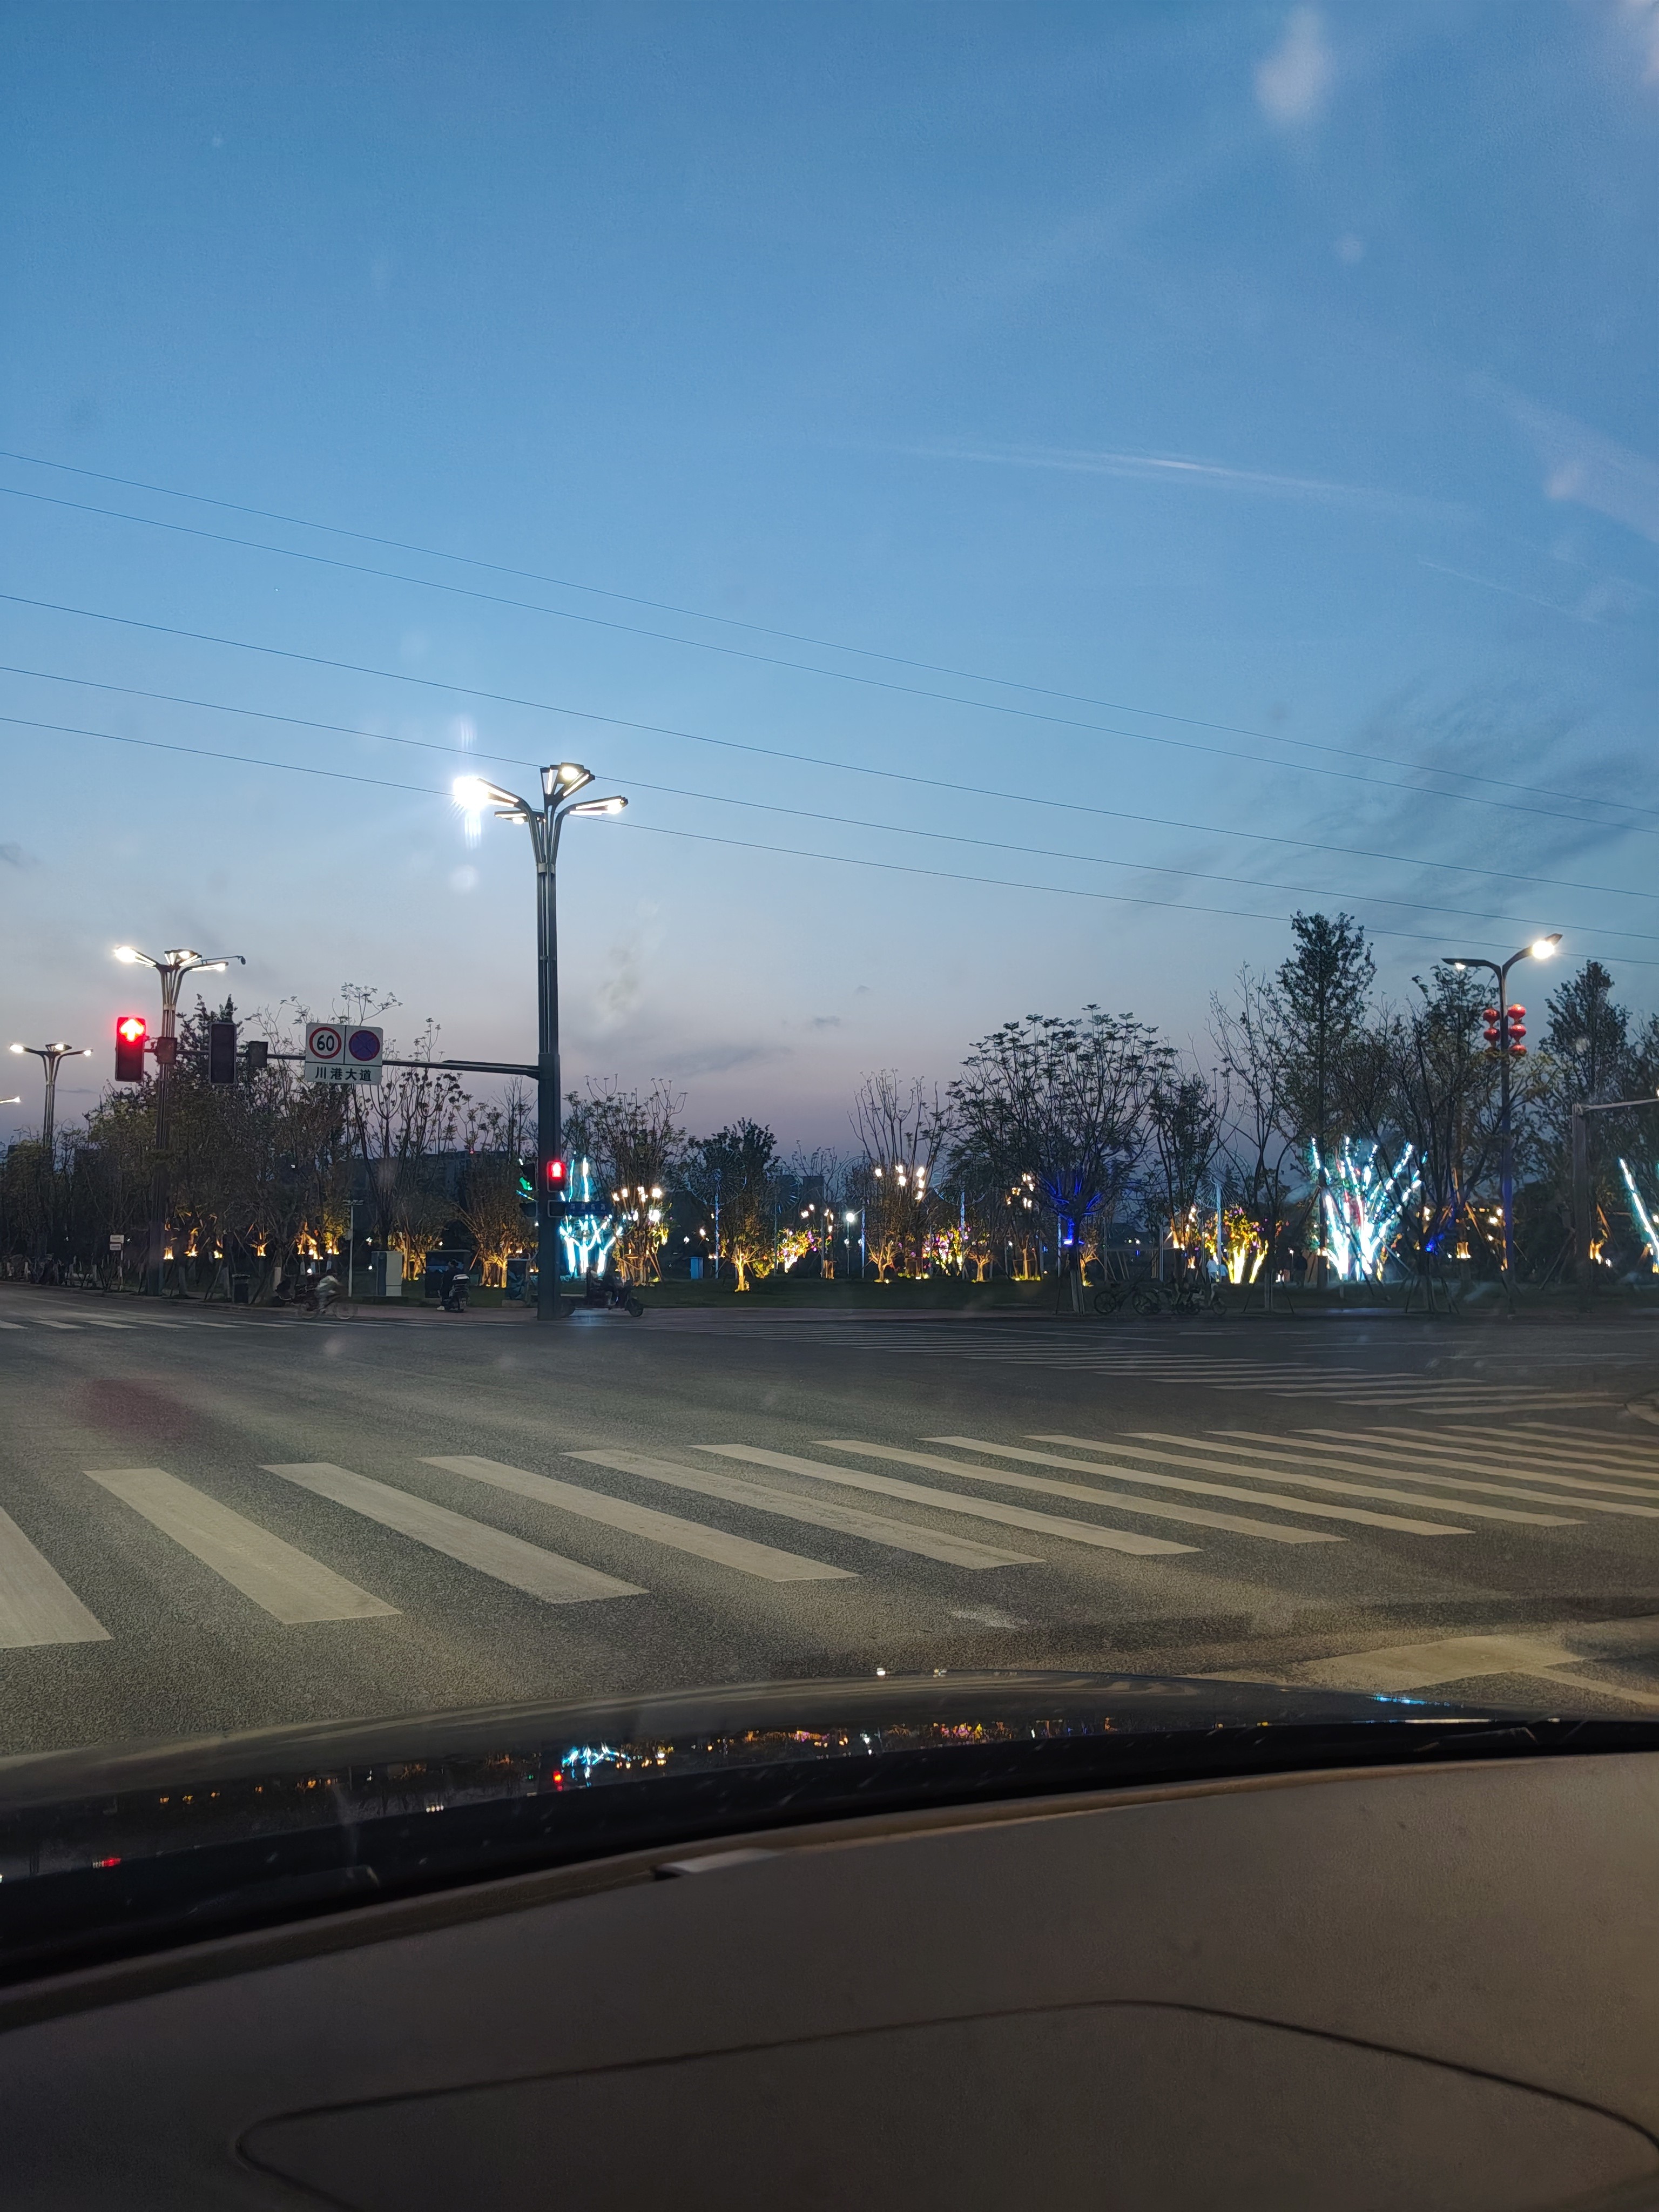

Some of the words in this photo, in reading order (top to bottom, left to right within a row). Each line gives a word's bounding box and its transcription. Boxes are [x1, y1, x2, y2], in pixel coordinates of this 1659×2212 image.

[317, 1035, 334, 1051] 60
[315, 1067, 372, 1081] 川港大道
